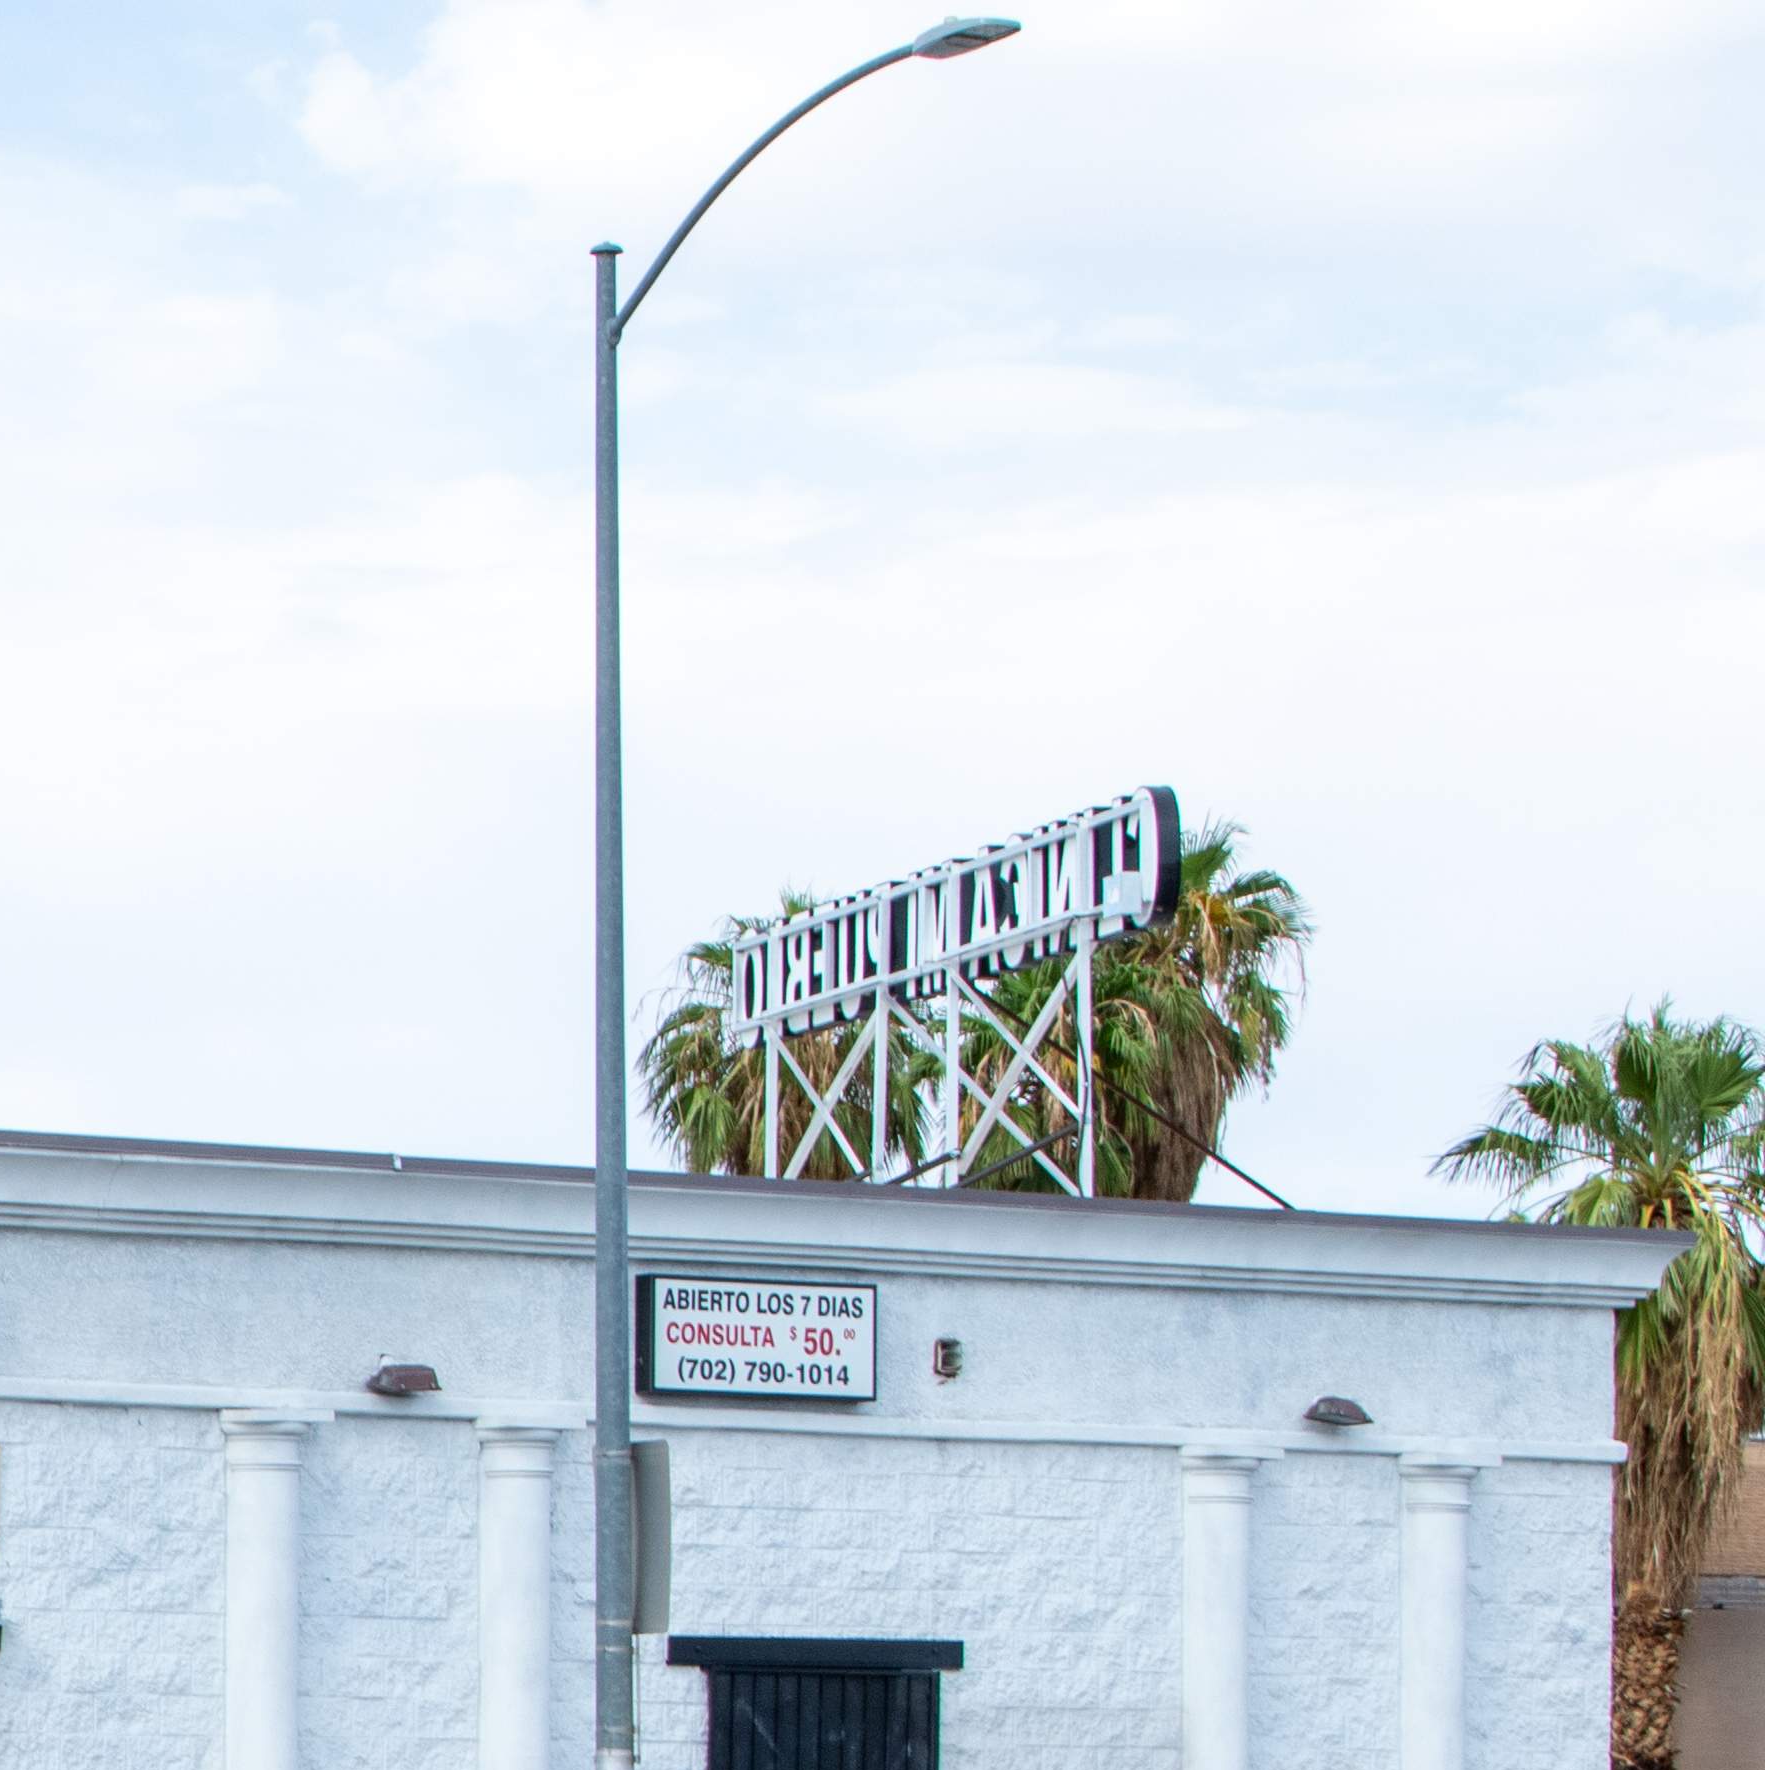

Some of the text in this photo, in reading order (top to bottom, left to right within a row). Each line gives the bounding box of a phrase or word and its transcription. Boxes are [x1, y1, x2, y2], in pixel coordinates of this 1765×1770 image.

[663, 1287, 864, 1318] ABIERTO LOS 7 DIAS
[665, 1321, 775, 1348] CONSULTA
[677, 1356, 849, 1386] (702) 790-1014
